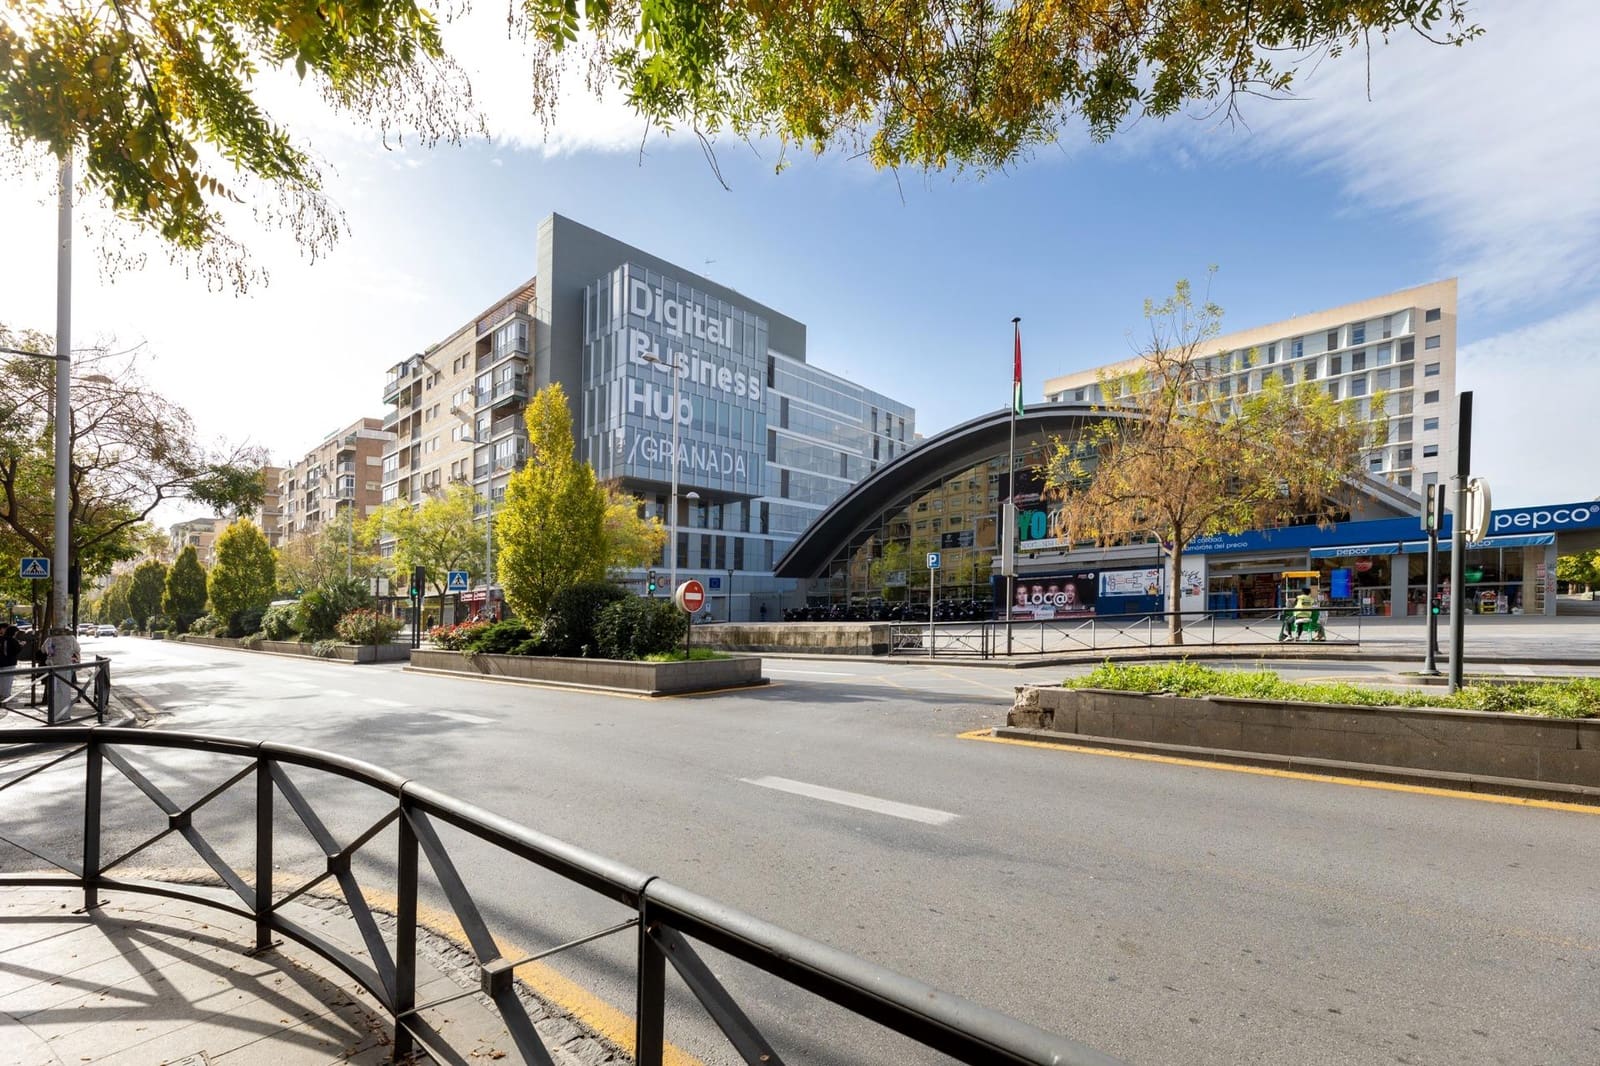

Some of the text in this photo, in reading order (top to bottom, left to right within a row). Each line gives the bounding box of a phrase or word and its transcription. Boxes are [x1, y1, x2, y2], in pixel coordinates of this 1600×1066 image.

[629, 278, 732, 348] Digital
[628, 327, 761, 401] Business
[627, 377, 694, 426] Hub
[627, 433, 747, 478] /GRANADA
[929, 554, 937, 566] P
[1024, 592, 1068, 607] LOC@
